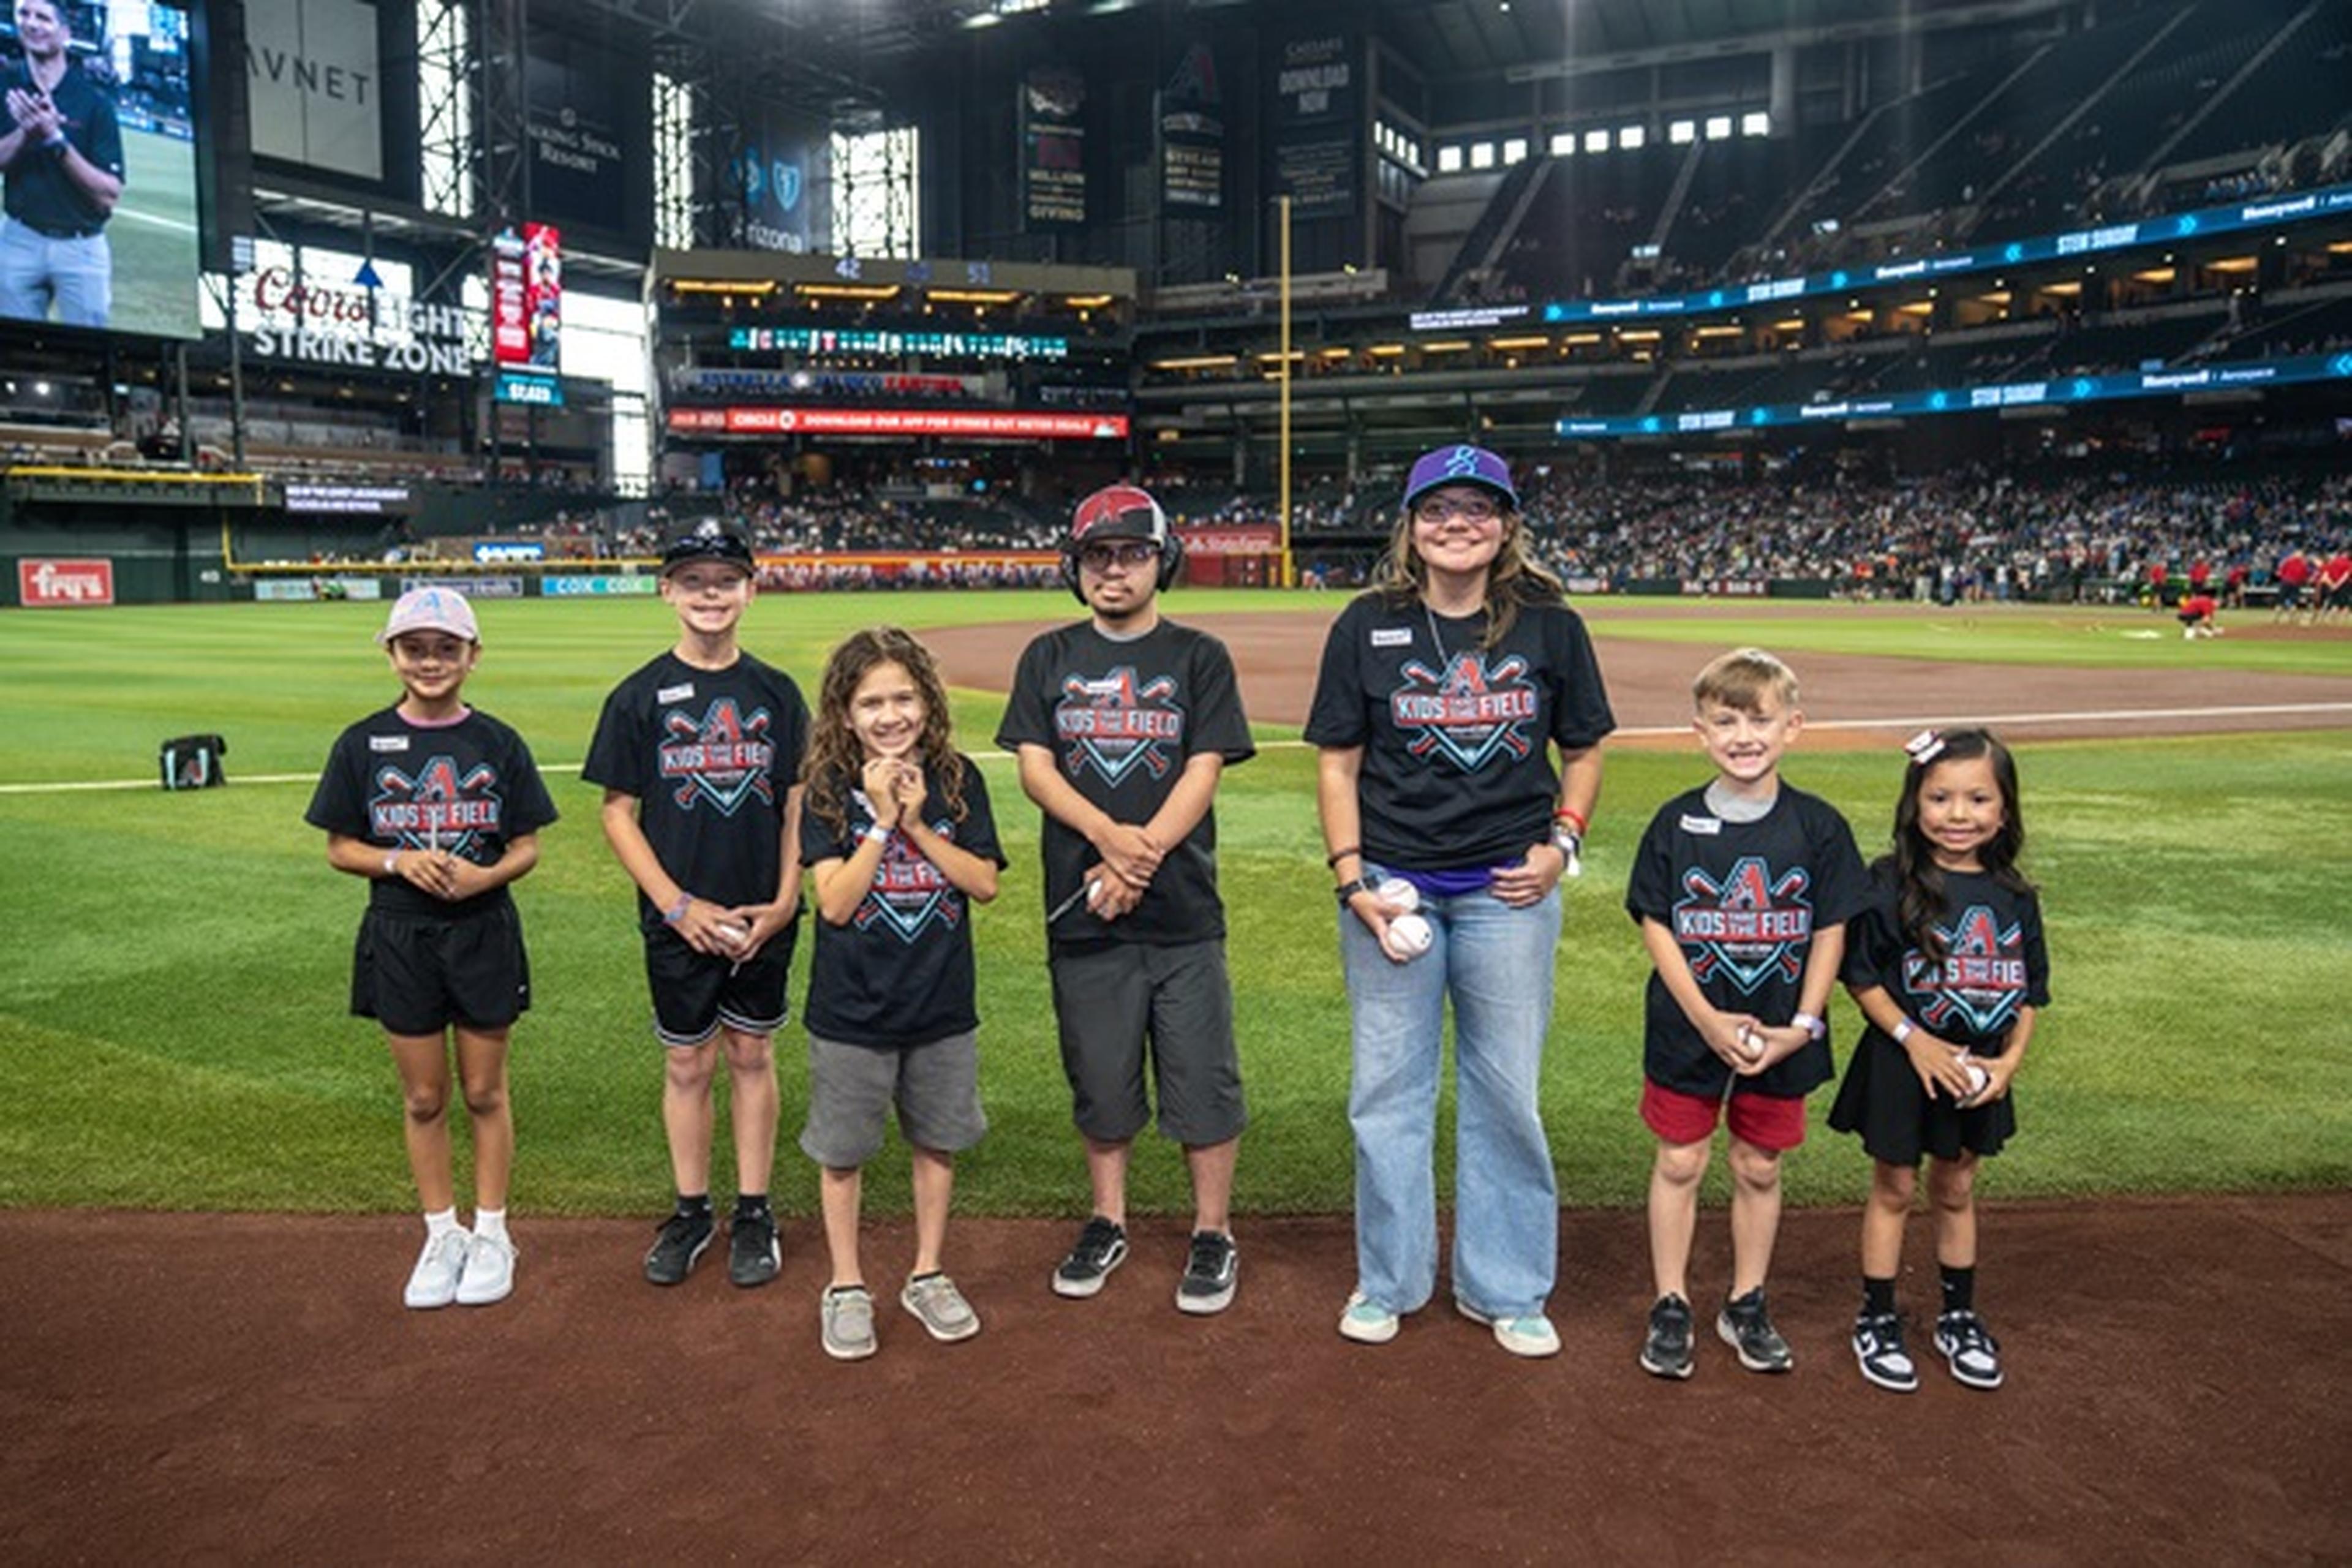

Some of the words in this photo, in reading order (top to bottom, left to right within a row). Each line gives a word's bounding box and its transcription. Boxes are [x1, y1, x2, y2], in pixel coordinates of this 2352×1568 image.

[253, 326, 375, 368] STRIKE
[1396, 695, 1446, 719] KIDS
[1479, 690, 1534, 718] FIELD
[1128, 710, 1179, 737] FIELD
[1679, 911, 1725, 935] KIDS
